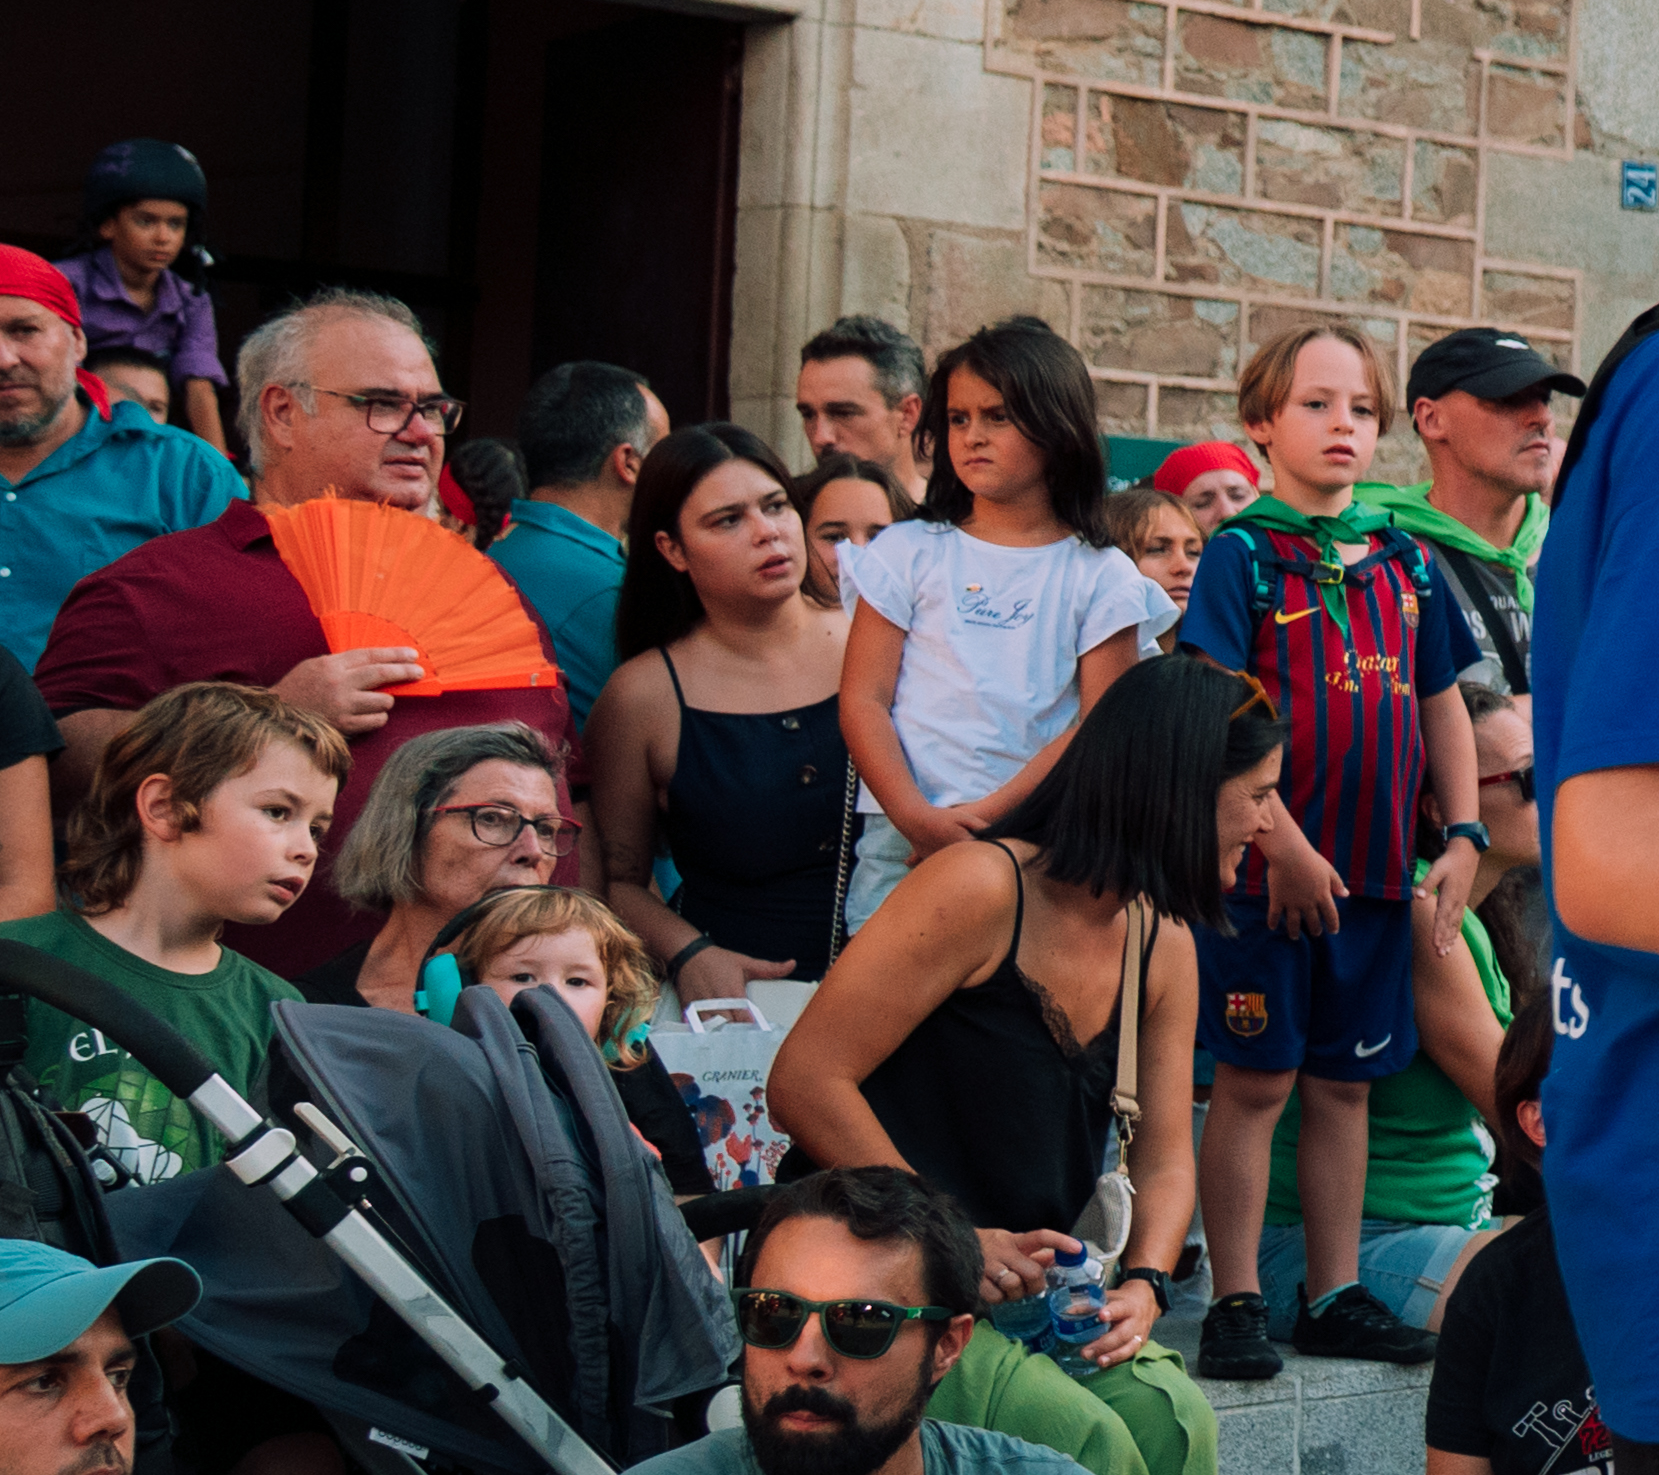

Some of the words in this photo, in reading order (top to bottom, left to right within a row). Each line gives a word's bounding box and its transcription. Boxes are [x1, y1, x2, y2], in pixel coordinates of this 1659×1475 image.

[1627, 169, 1656, 206] 24
[957, 593, 1001, 618] Pure
[69, 1028, 118, 1062] EL
